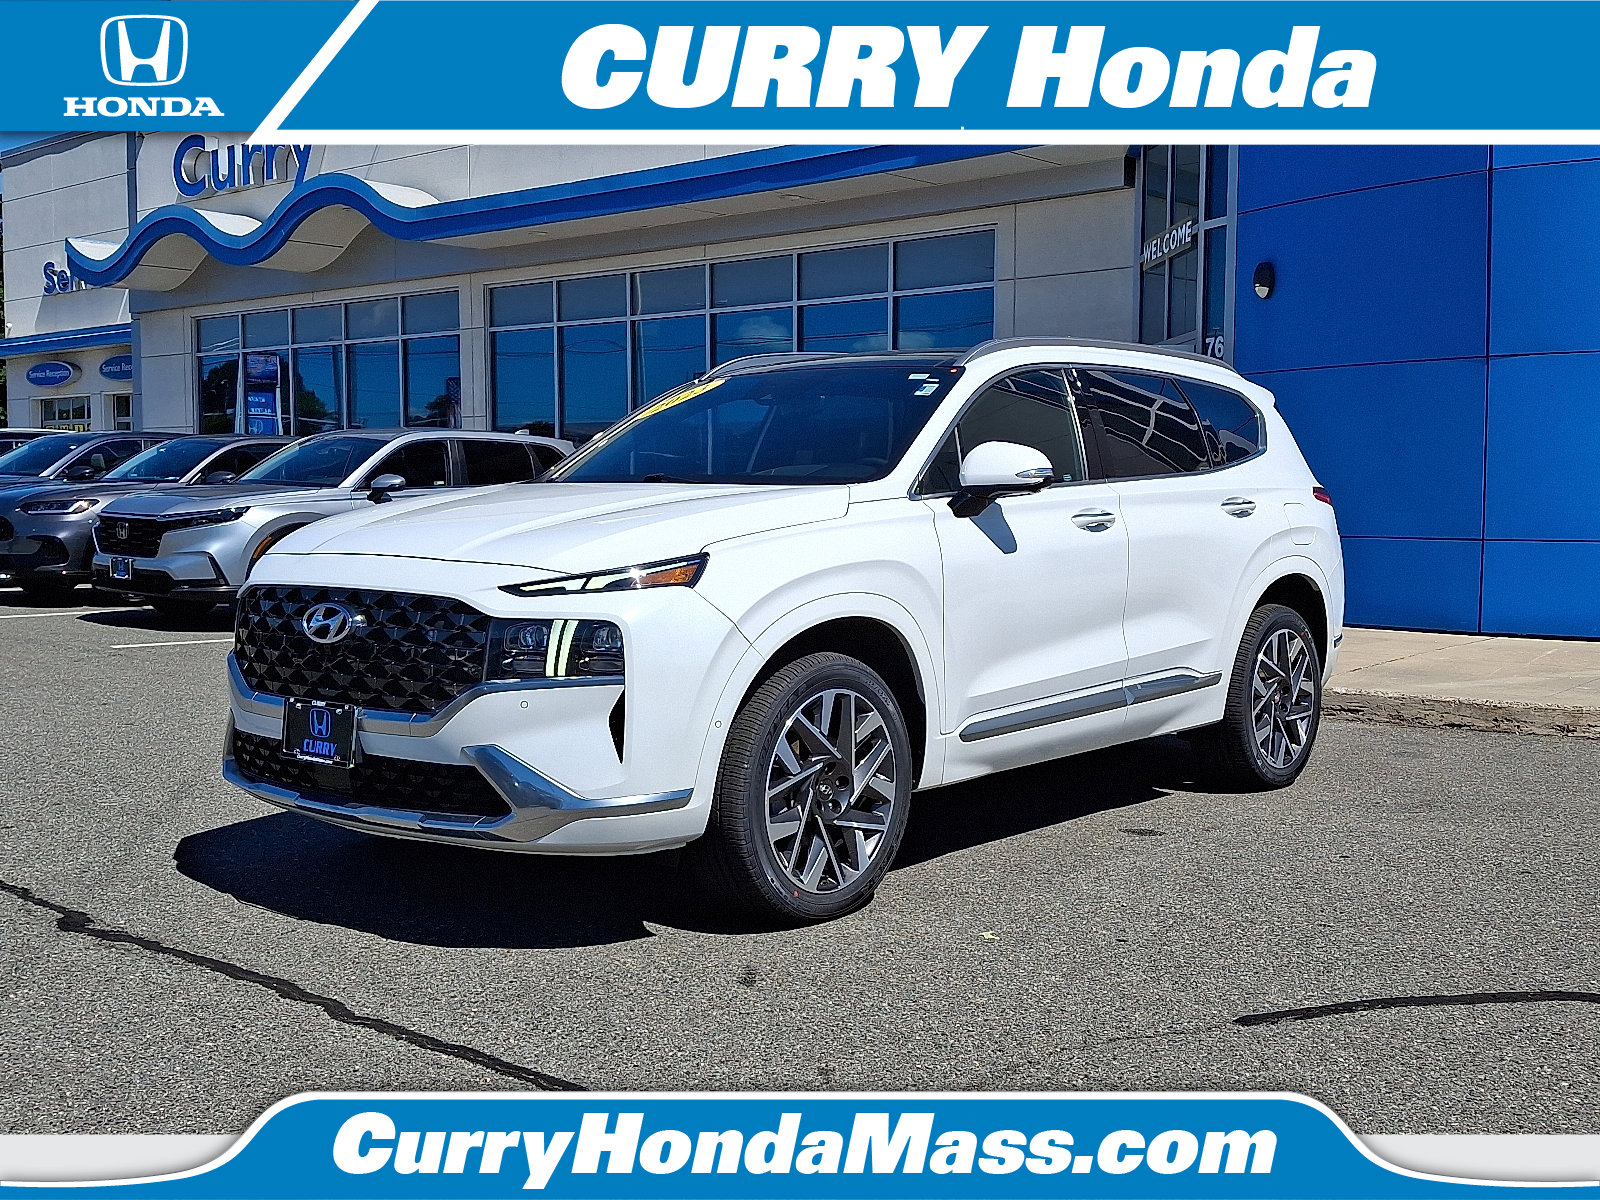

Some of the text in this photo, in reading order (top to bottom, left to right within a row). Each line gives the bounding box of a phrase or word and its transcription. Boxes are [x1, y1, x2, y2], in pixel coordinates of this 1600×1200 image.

[173, 134, 313, 197] Curry
[1143, 220, 1192, 263] WELCOME
[1205, 335, 1224, 358] 76
[29, 368, 70, 379] Service Reception
[102, 364, 121, 373] Service
[303, 738, 338, 756] CURRY
